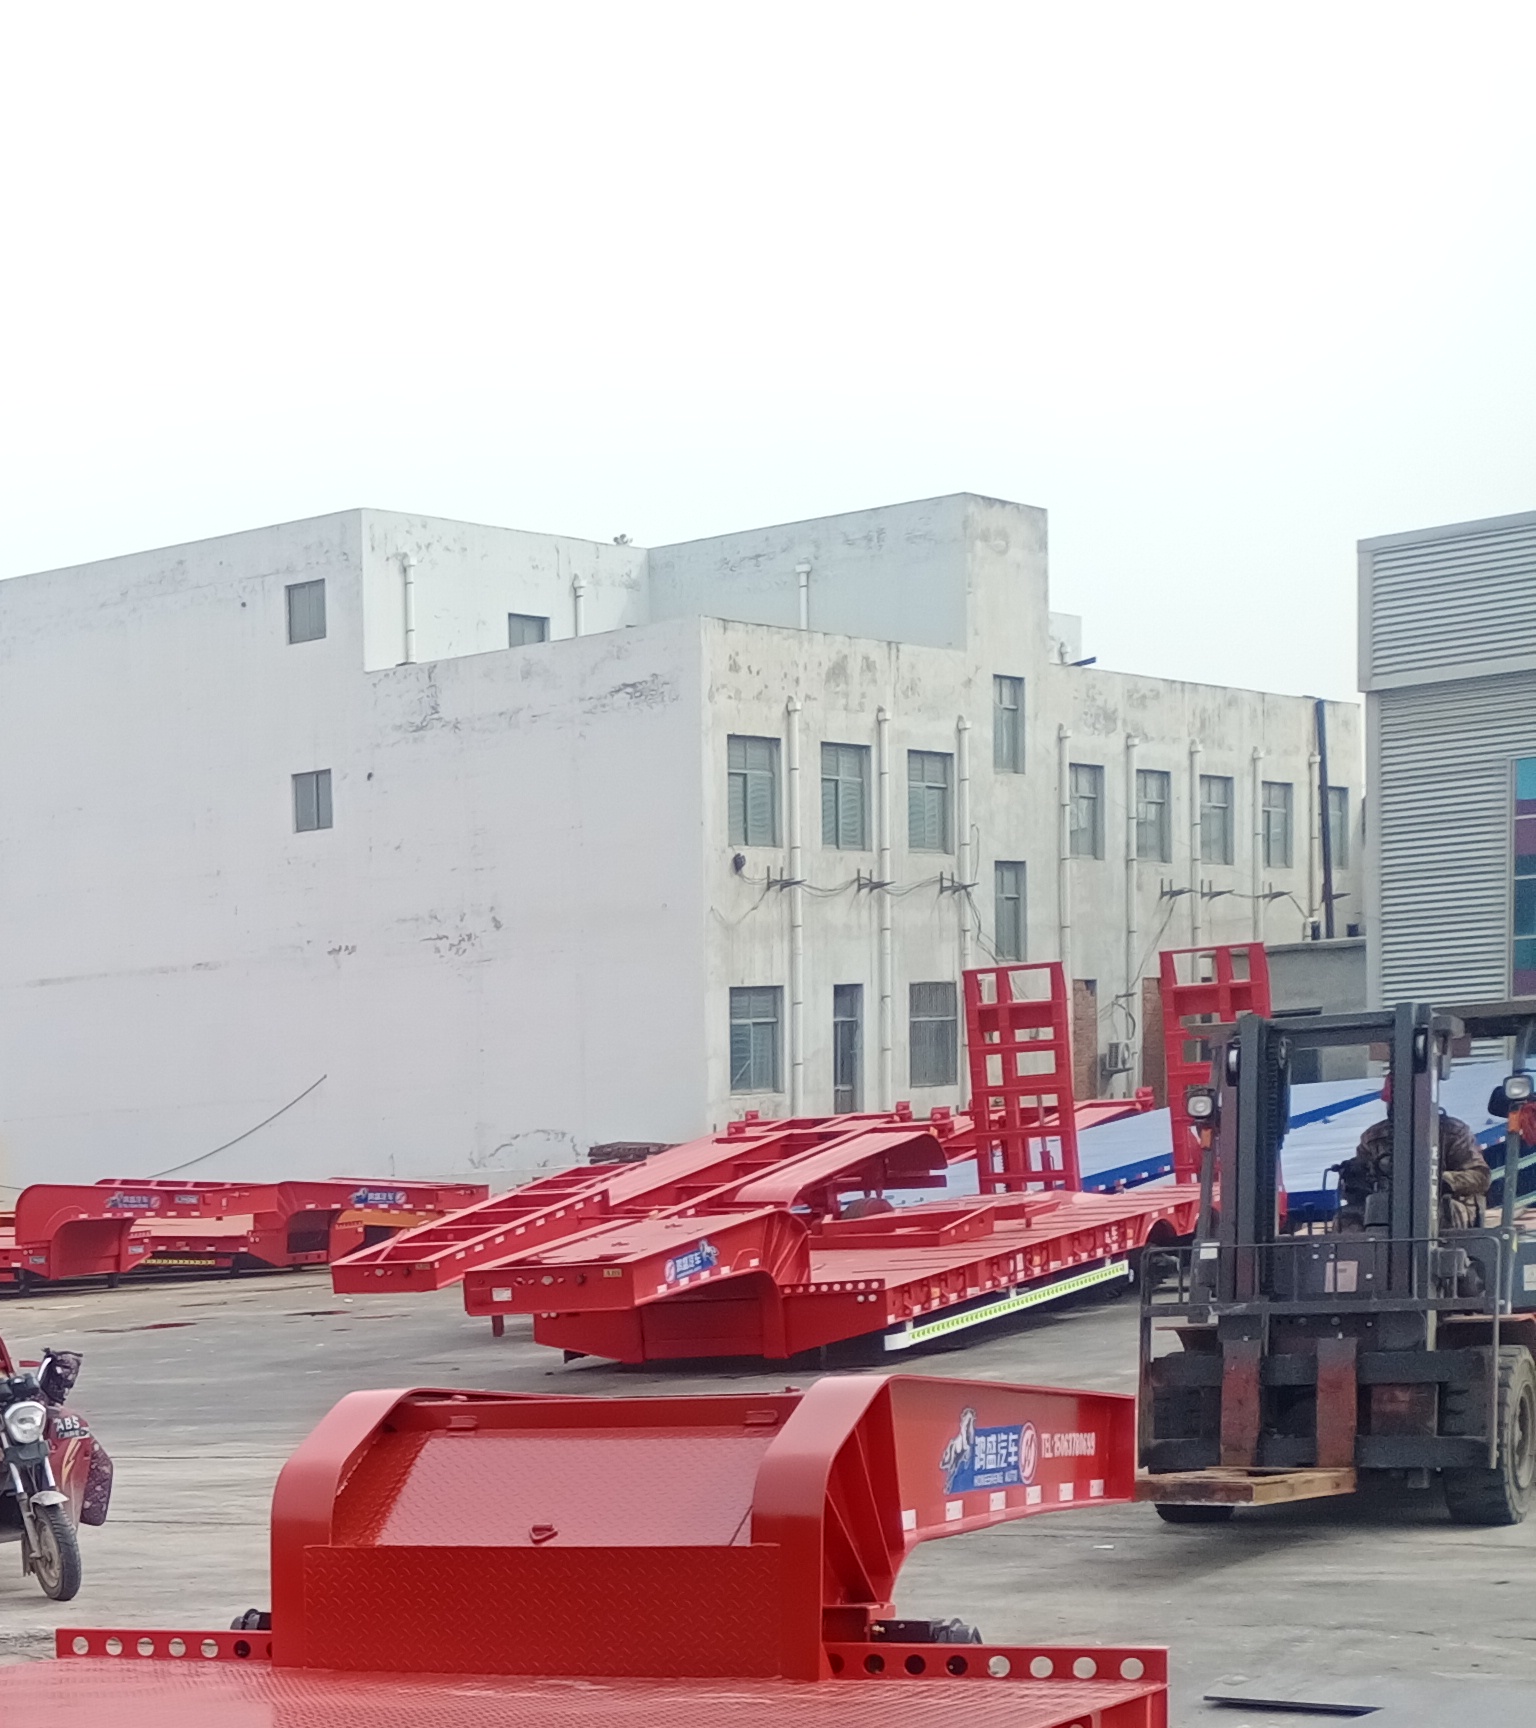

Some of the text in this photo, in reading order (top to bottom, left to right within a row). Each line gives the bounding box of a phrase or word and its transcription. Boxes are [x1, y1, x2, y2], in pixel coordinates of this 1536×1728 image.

[53, 1415, 80, 1432] ABS
[974, 1432, 1019, 1472] 鸿盛汽车
